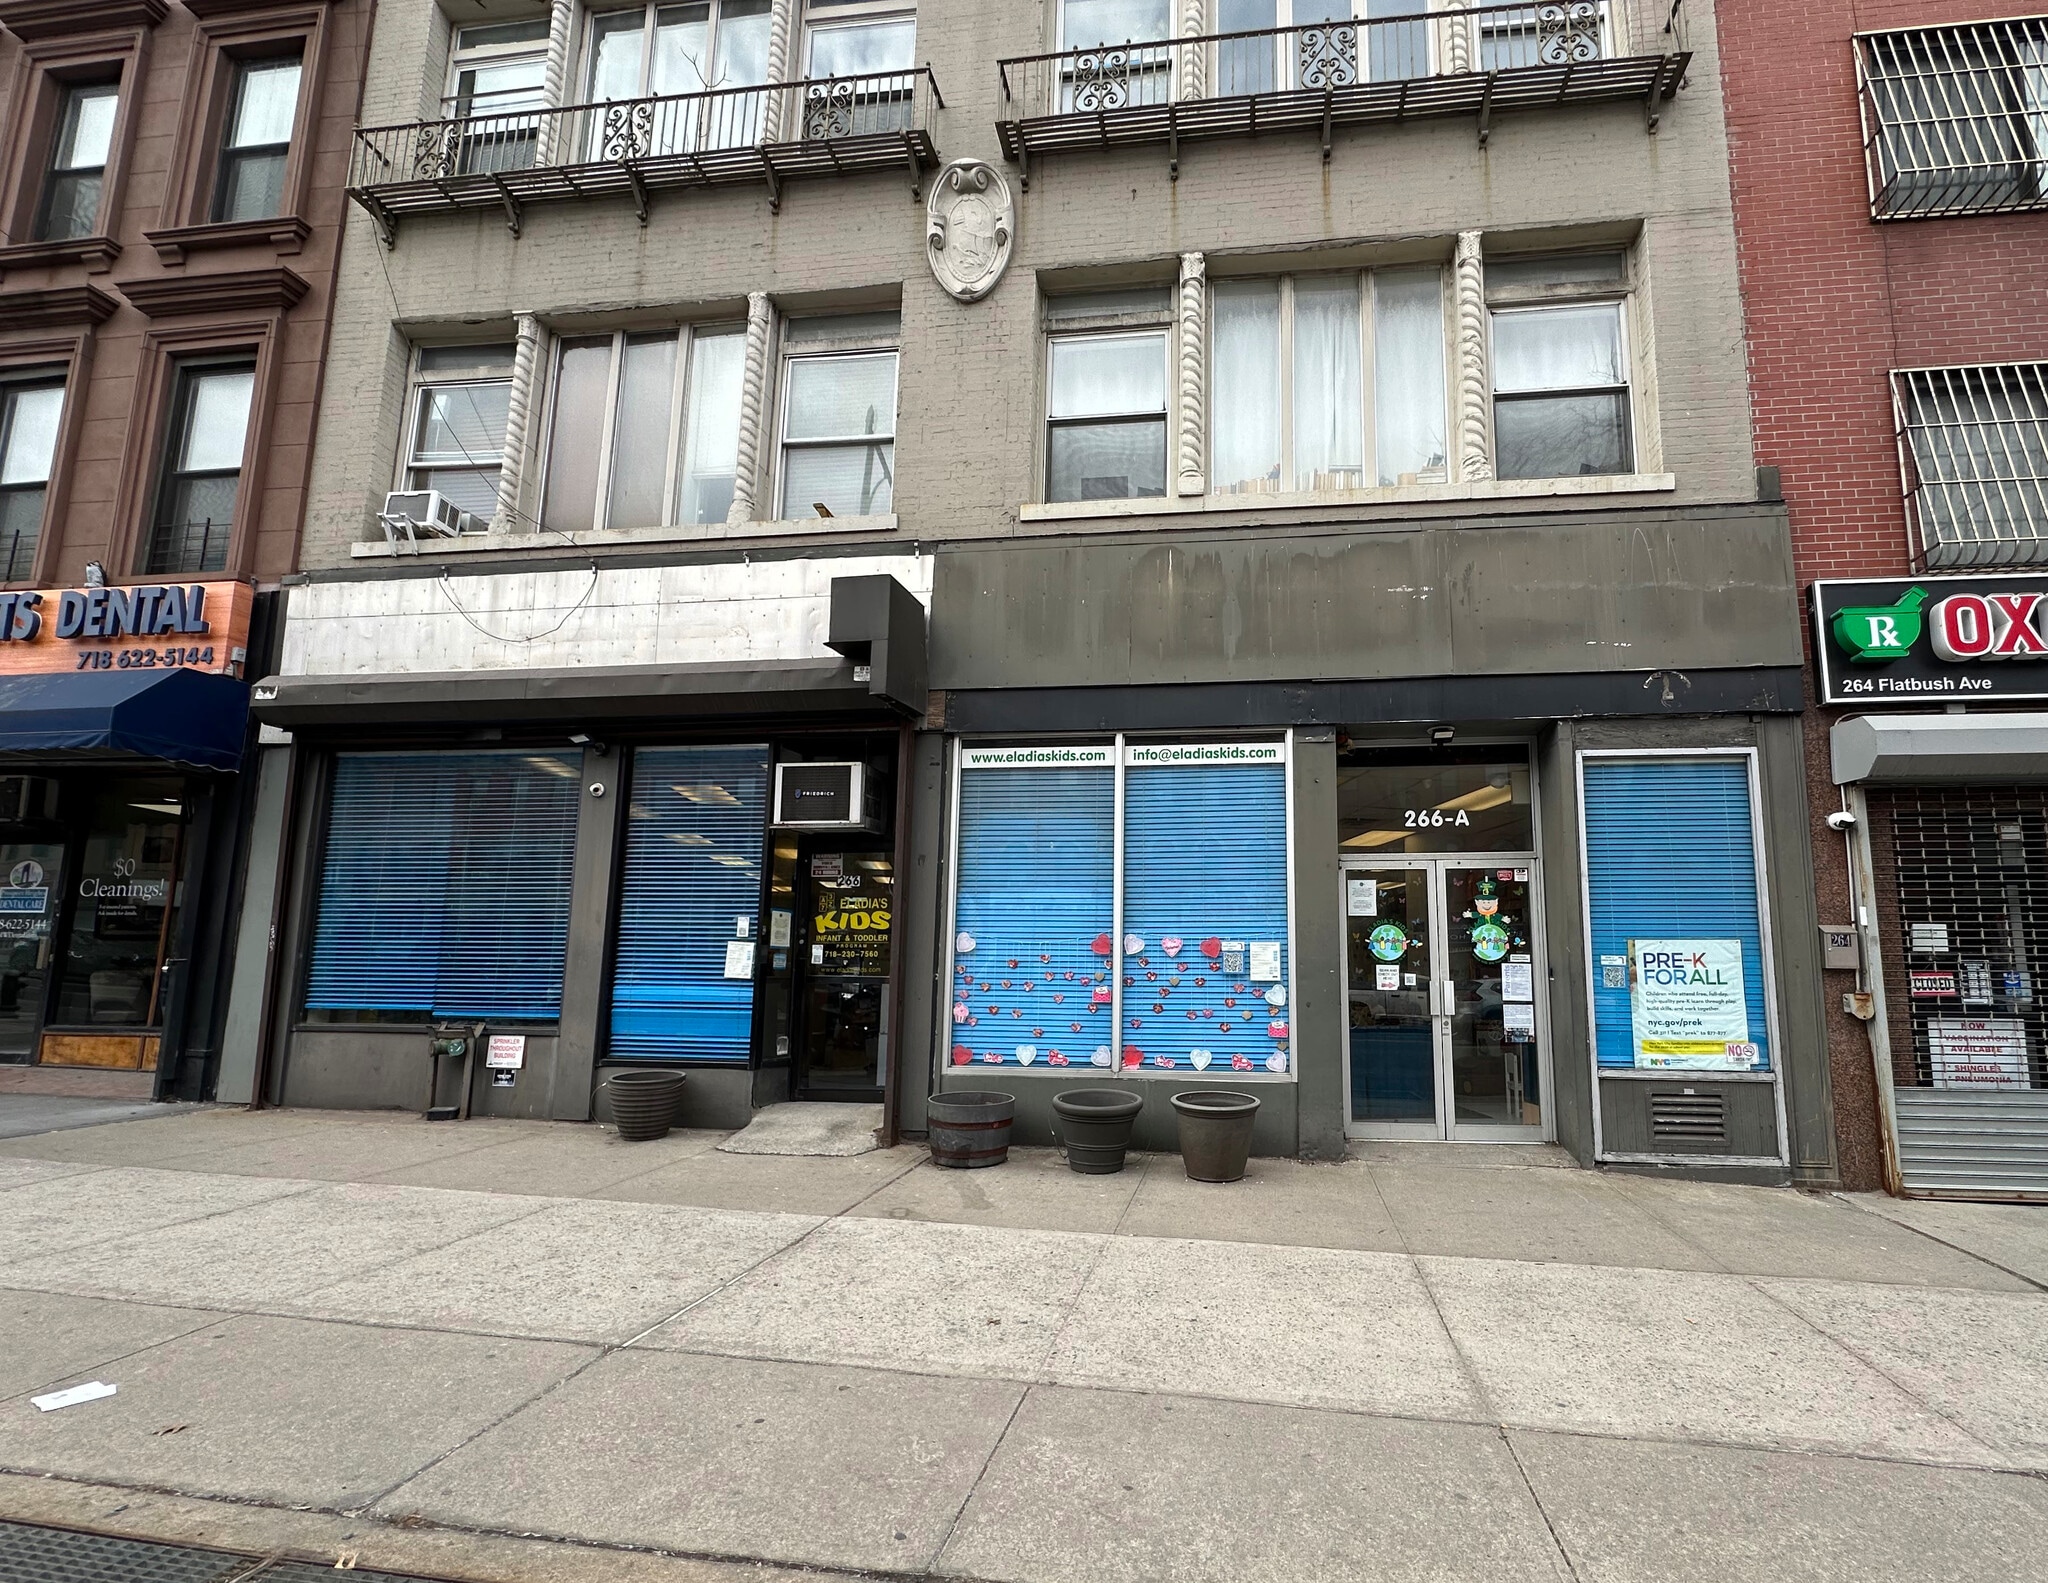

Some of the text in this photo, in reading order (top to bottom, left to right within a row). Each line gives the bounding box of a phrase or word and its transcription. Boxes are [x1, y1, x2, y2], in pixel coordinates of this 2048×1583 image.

[0, 585, 211, 641] TS DENTAL
[77, 647, 213, 669] 718 622-5144
[1843, 676, 1992, 693] 264 Flatbush Ave
[971, 748, 1106, 764] www.eladiaskids.com
[1133, 746, 1277, 762] info@eladiaskids.com
[1404, 809, 1470, 827] 266-A
[114, 858, 136, 878] $0
[79, 878, 165, 900] Cleanings!
[837, 875, 859, 887] 266
[840, 898, 888, 909] ELADIA'S
[815, 910, 892, 933] KIDS
[816, 934, 841, 942] INFANT
[854, 934, 888, 942] TODDLER
[1831, 934, 1850, 947] 264
[824, 950, 879, 958] 718-230-7560
[1643, 952, 1707, 968] PRE-K
[1644, 969, 1728, 985] FOR ALL
[1912, 977, 1952, 991] CLOSED
[1648, 1018, 1702, 1027] nyc.gov/prek
[1944, 1034, 2009, 1042] VACCINATION
[1728, 1046, 1742, 1056] NO
